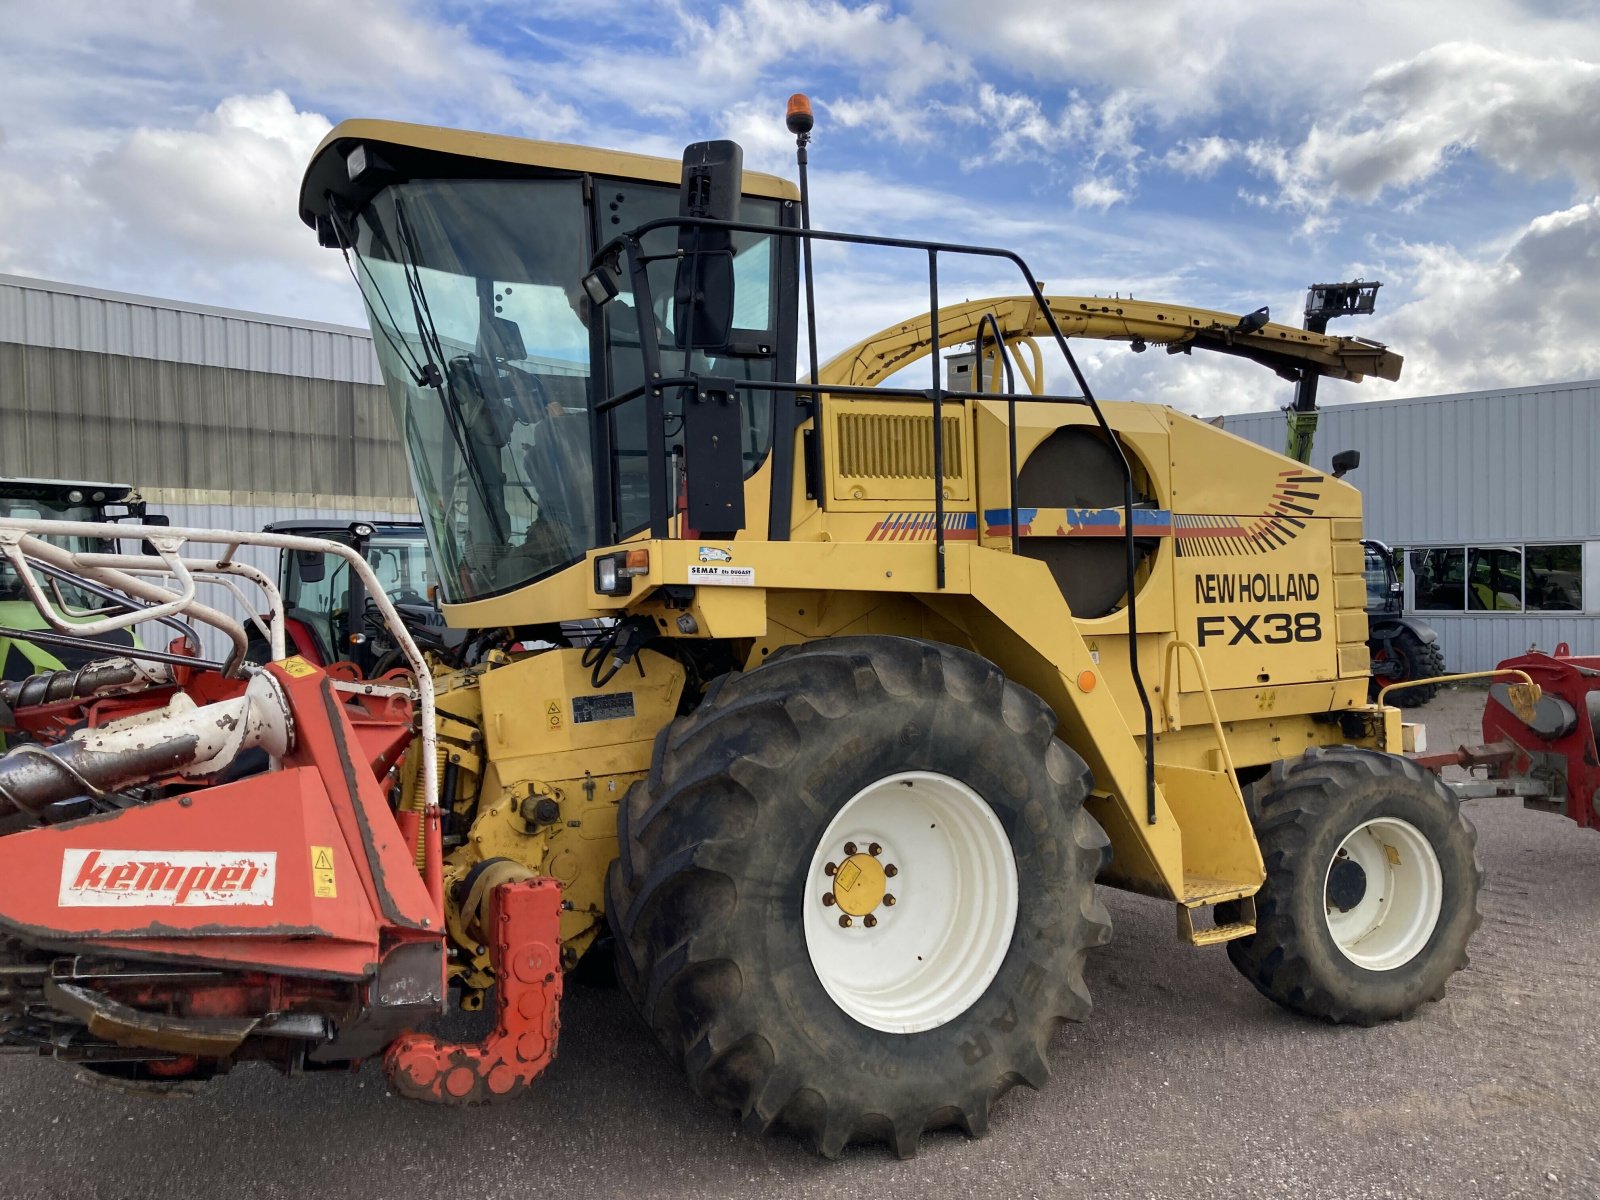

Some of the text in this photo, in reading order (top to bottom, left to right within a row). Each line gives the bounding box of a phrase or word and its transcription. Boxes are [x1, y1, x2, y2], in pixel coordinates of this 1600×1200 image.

[1195, 573, 1320, 604] NEW HOLLAND
[1196, 612, 1322, 647] FX38
[74, 851, 267, 905] kemper
